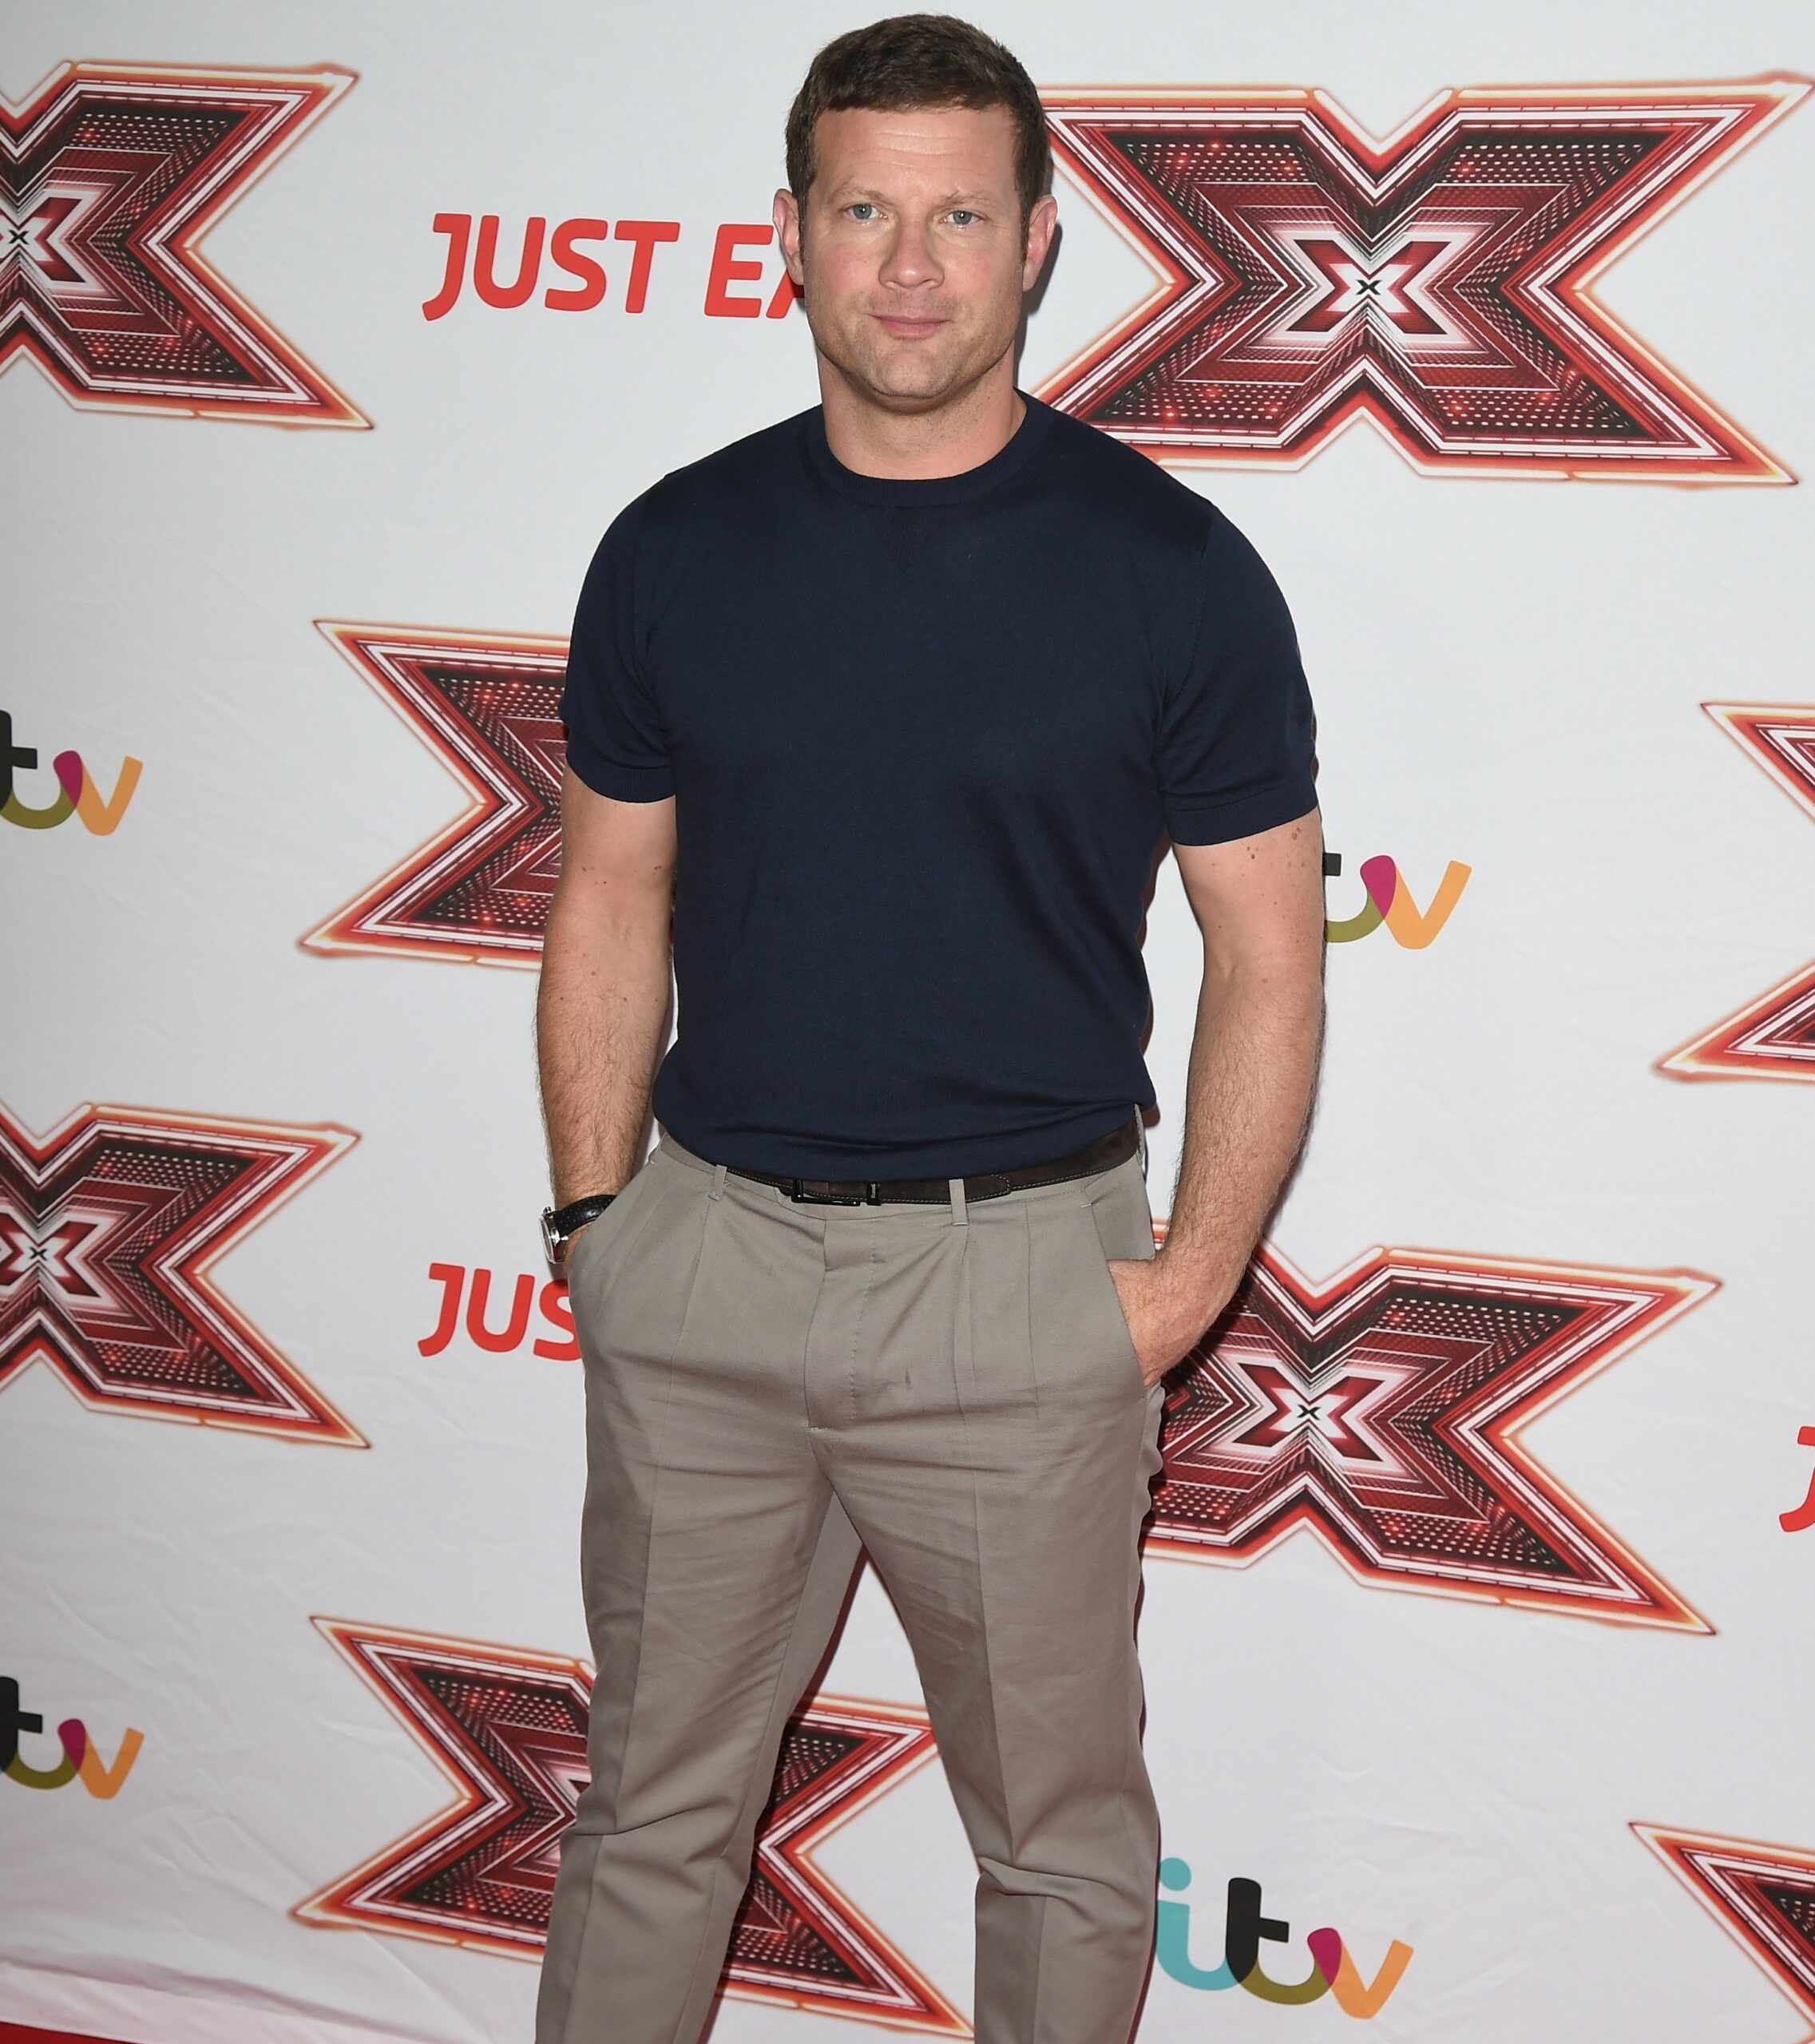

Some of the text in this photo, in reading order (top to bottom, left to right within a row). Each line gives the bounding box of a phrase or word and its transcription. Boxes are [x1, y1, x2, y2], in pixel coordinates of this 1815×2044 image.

[422, 212, 681, 322] JUST
[1030, 70, 1815, 486] X
[1156, 1857, 1414, 2020] itv
